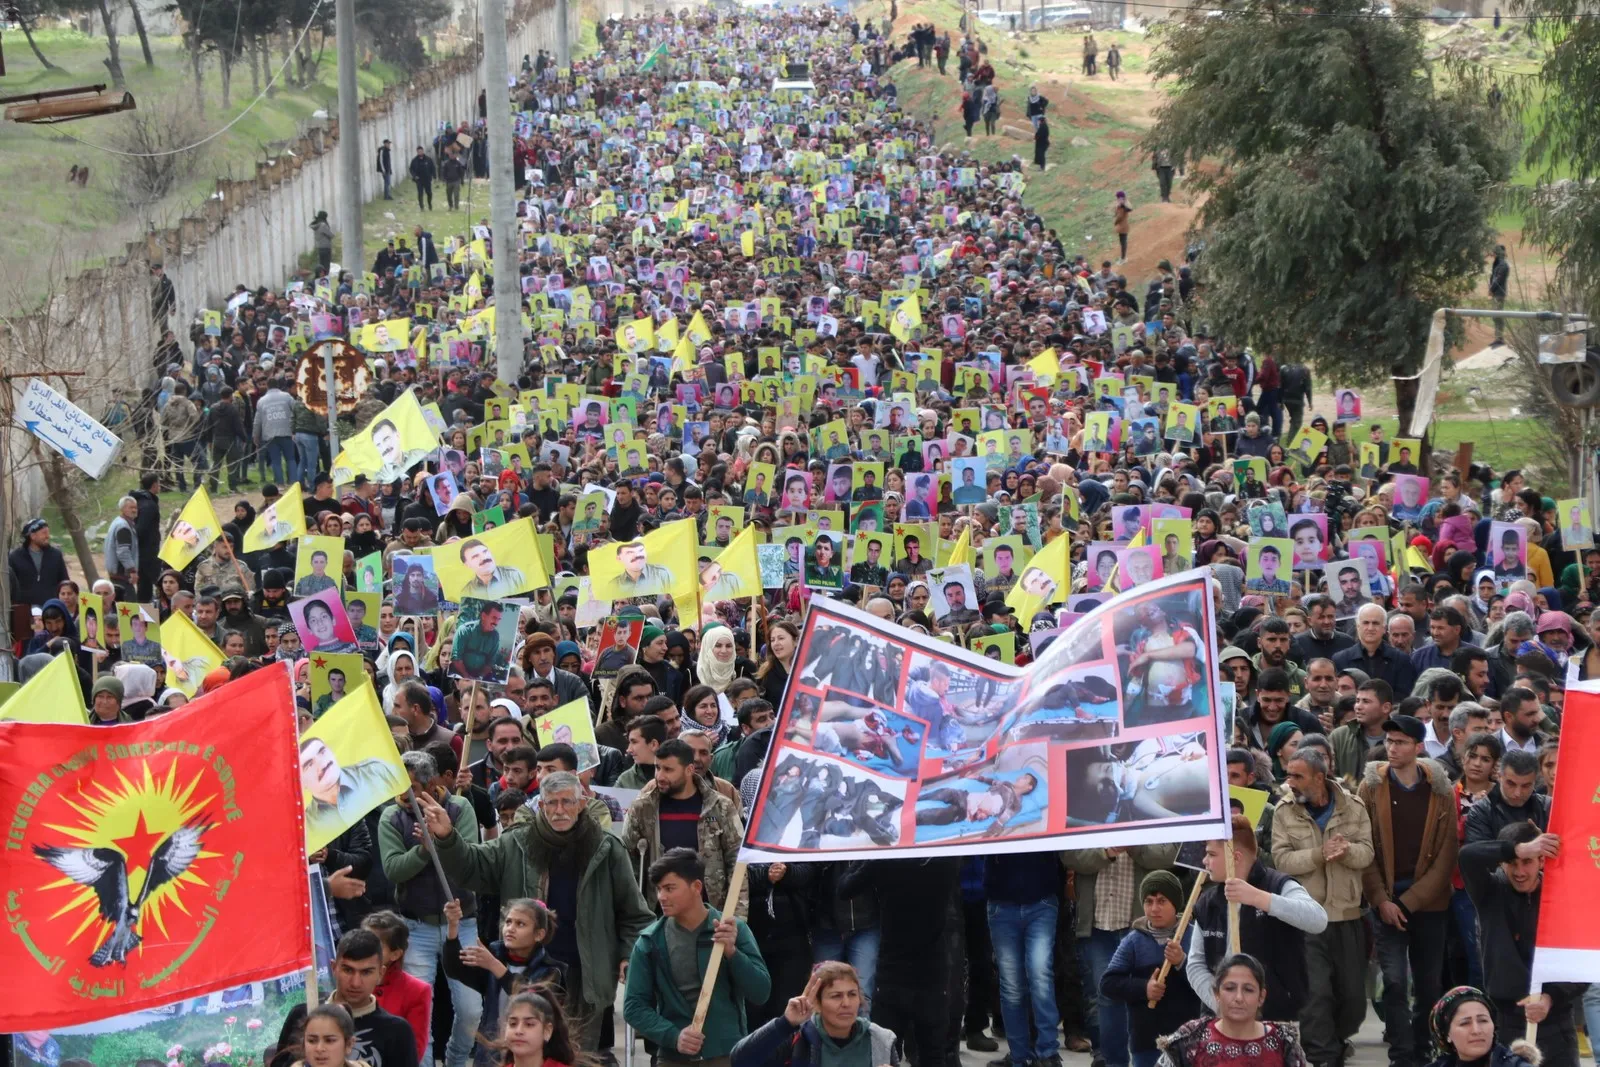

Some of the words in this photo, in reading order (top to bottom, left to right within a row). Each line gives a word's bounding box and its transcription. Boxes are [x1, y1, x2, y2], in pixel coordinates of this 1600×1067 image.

[31, 384, 52, 400] البديل
[50, 399, 68, 411] الطب
[52, 424, 73, 439] أحمد
[91, 429, 112, 447] معالج
[72, 436, 93, 454] محمد
[6, 771, 56, 850] TEVGERA
[5, 887, 66, 975] السورية
[138, 904, 220, 990] الشبيبة
[68, 968, 125, 1000] الثورية
